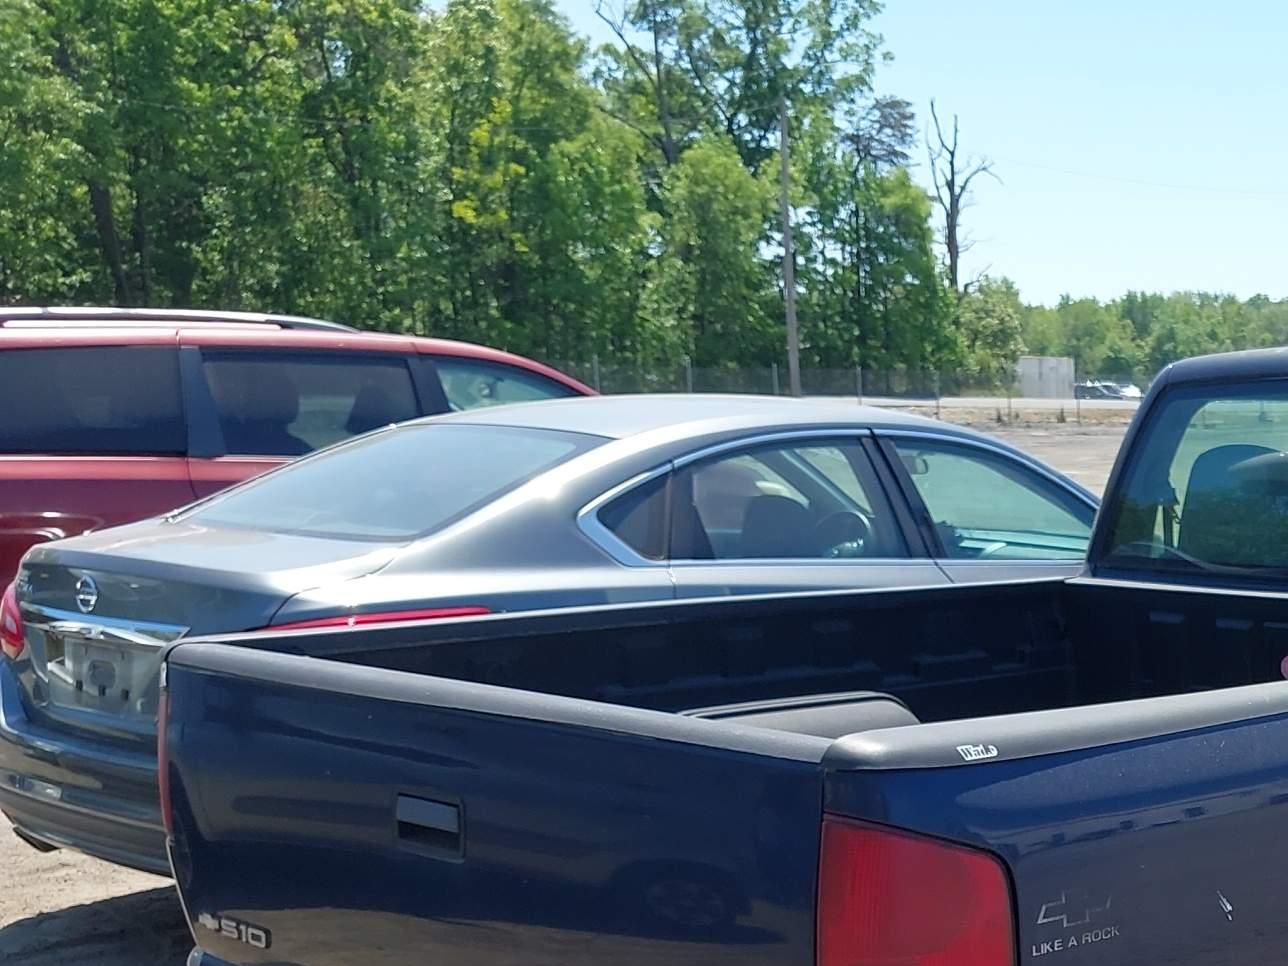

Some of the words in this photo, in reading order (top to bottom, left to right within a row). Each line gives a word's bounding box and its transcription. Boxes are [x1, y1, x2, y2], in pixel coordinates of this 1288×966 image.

[220, 919, 267, 949] S10
[1032, 939, 1064, 957] LIKE
[1068, 935, 1078, 948] A
[1082, 925, 1120, 944] ROCK
